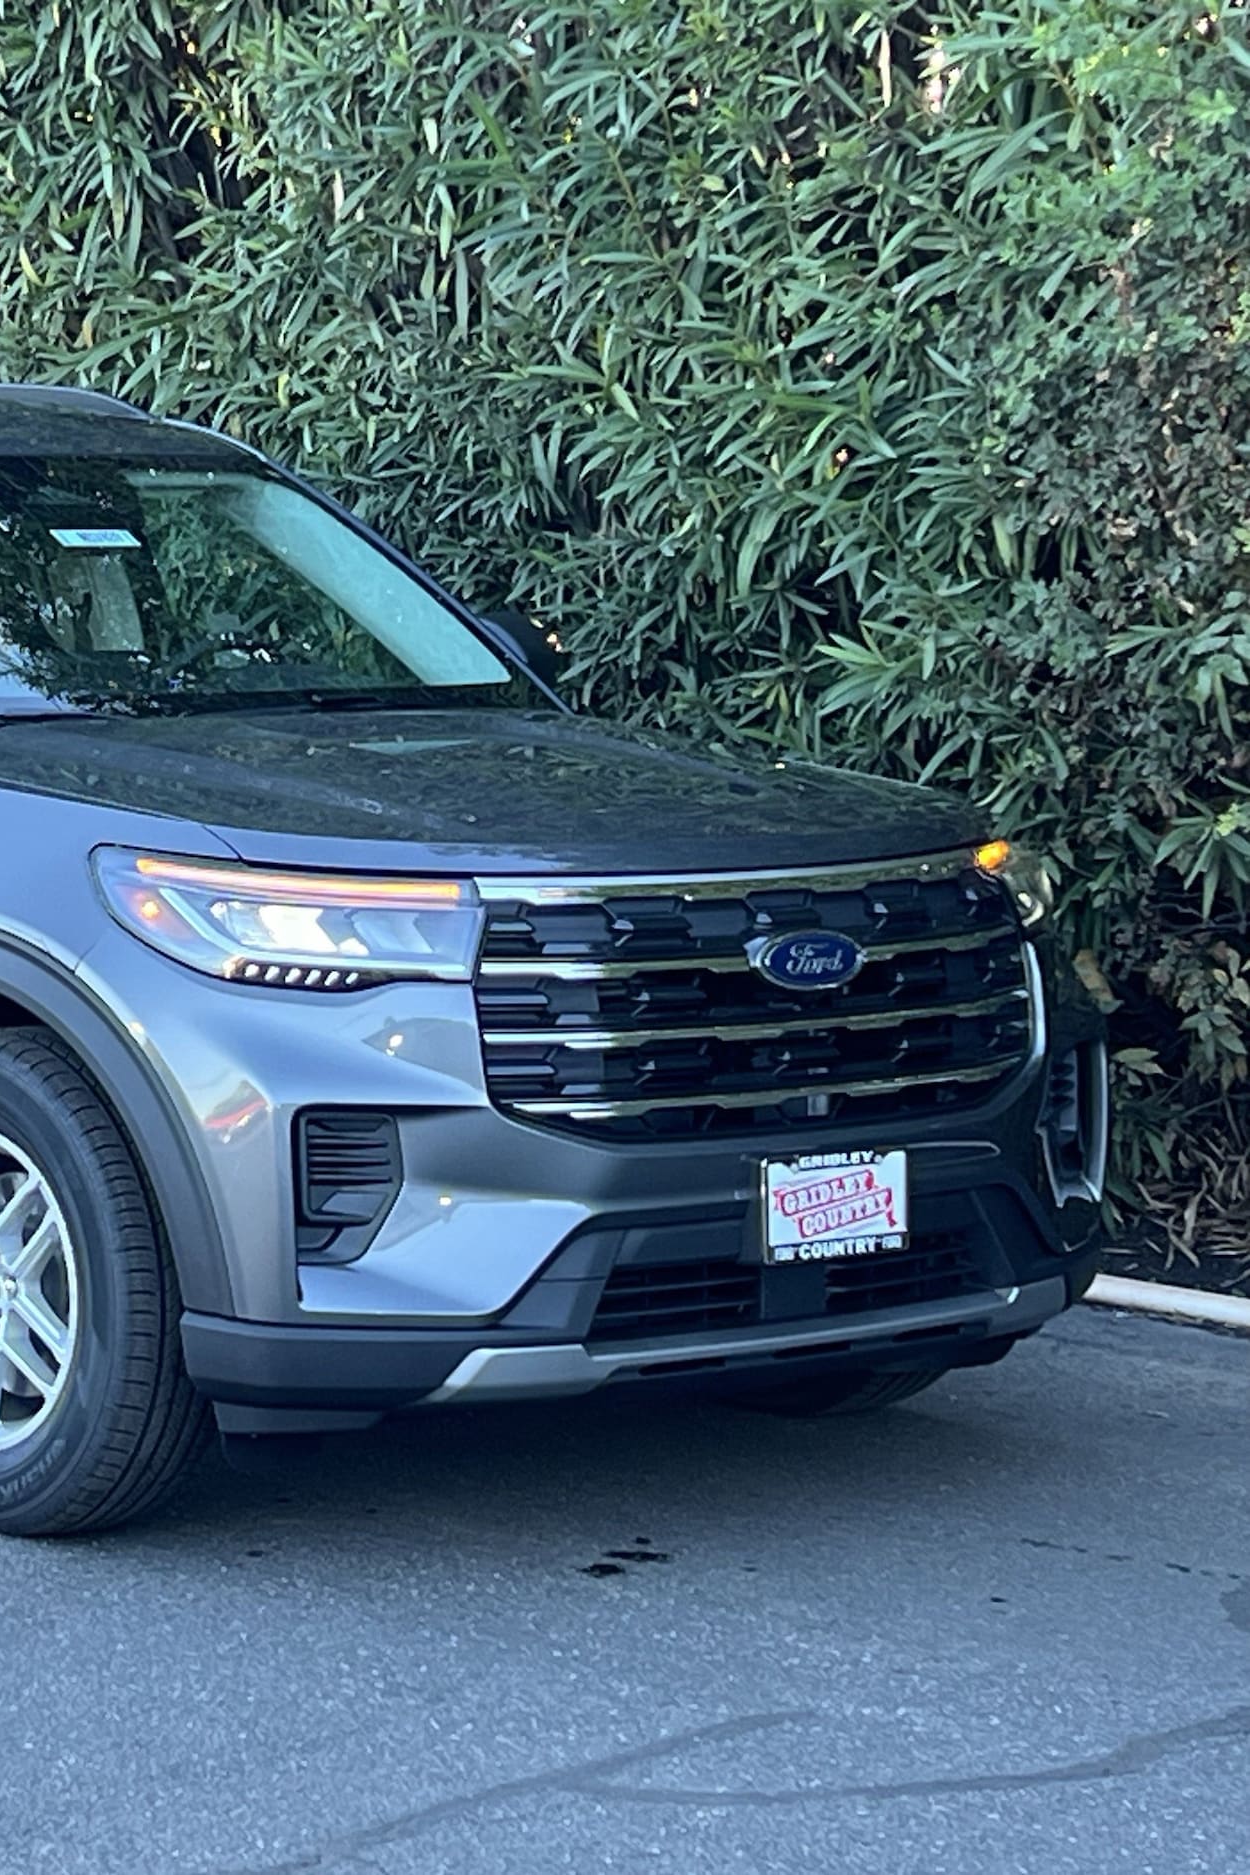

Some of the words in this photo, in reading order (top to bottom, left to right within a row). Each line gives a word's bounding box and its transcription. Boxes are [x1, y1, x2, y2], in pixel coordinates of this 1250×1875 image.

[786, 943, 844, 975] Ford
[800, 1150, 874, 1167] GRIDLEY
[784, 1172, 869, 1212] GRIDLEY
[802, 1192, 887, 1236] COUNTRY
[798, 1236, 877, 1260] COUNTRY
